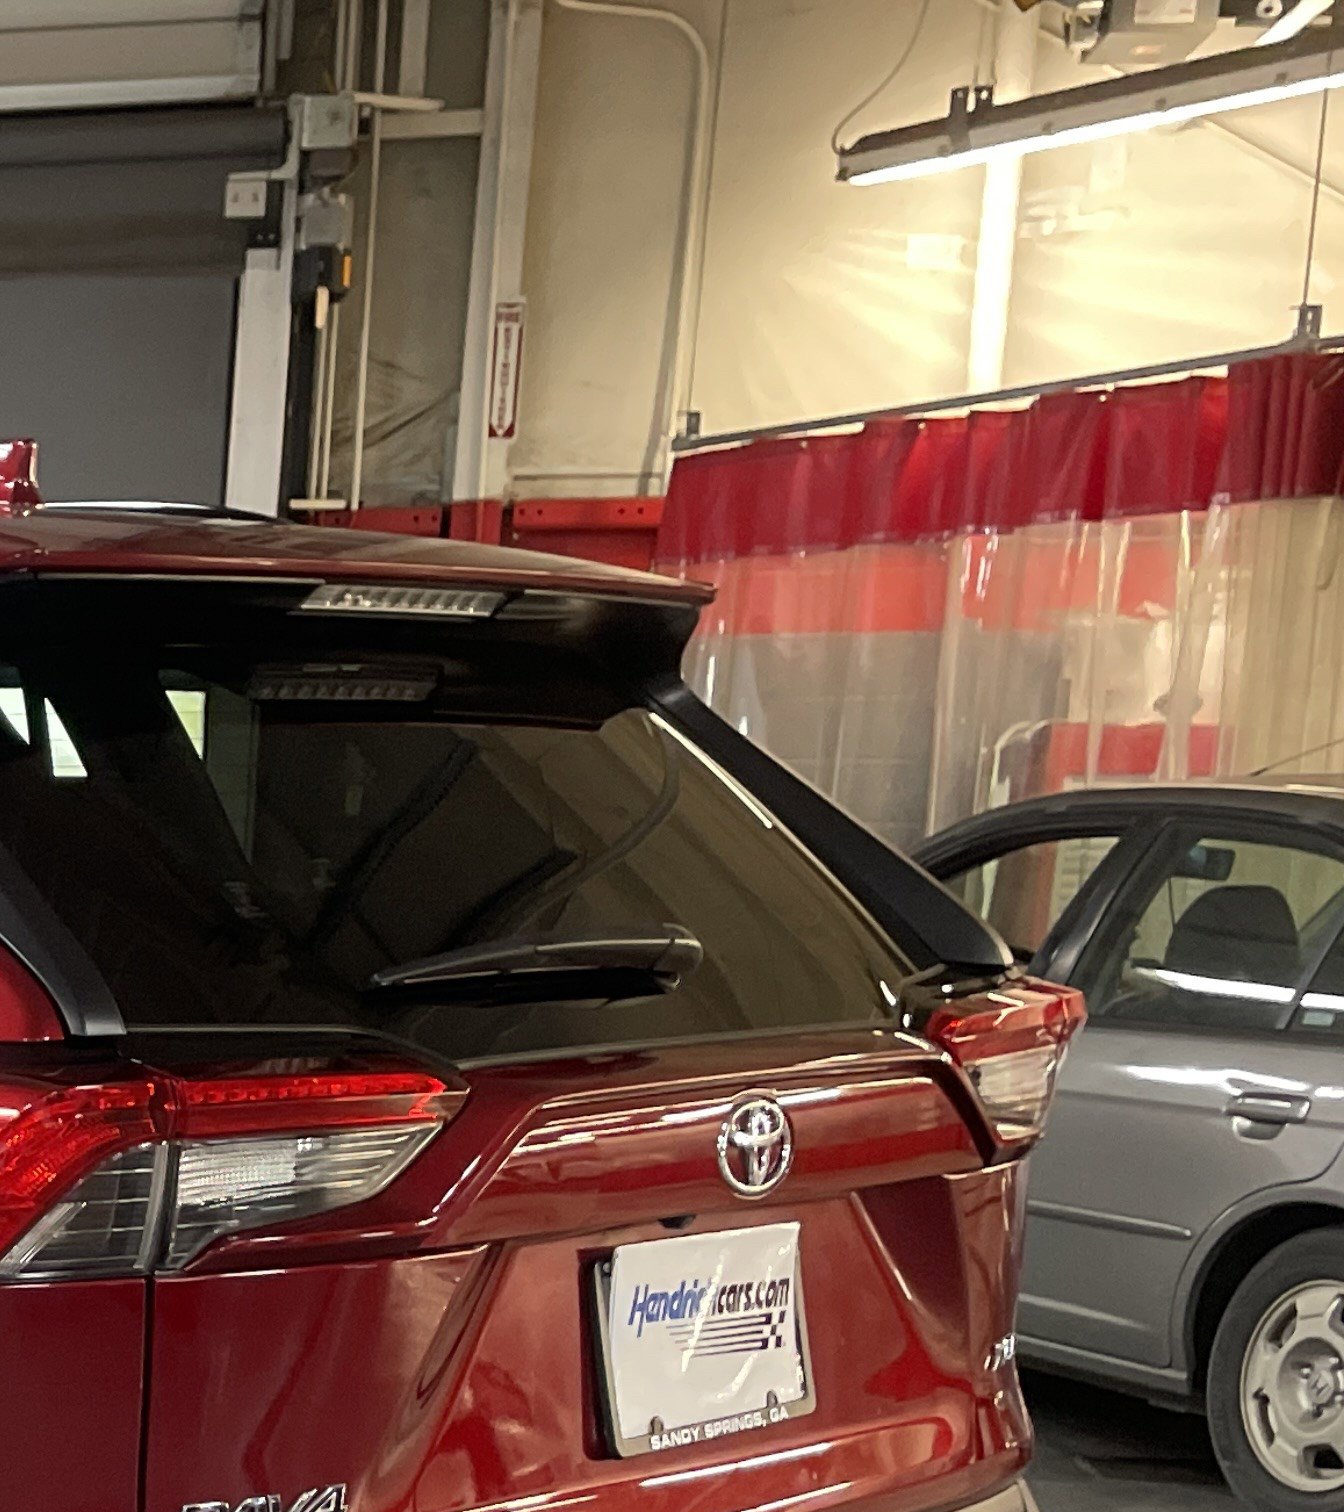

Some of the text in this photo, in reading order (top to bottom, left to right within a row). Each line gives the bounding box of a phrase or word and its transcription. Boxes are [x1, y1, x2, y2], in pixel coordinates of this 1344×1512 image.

[650, 1405, 789, 1450] SANDY SPRINGS, GA
